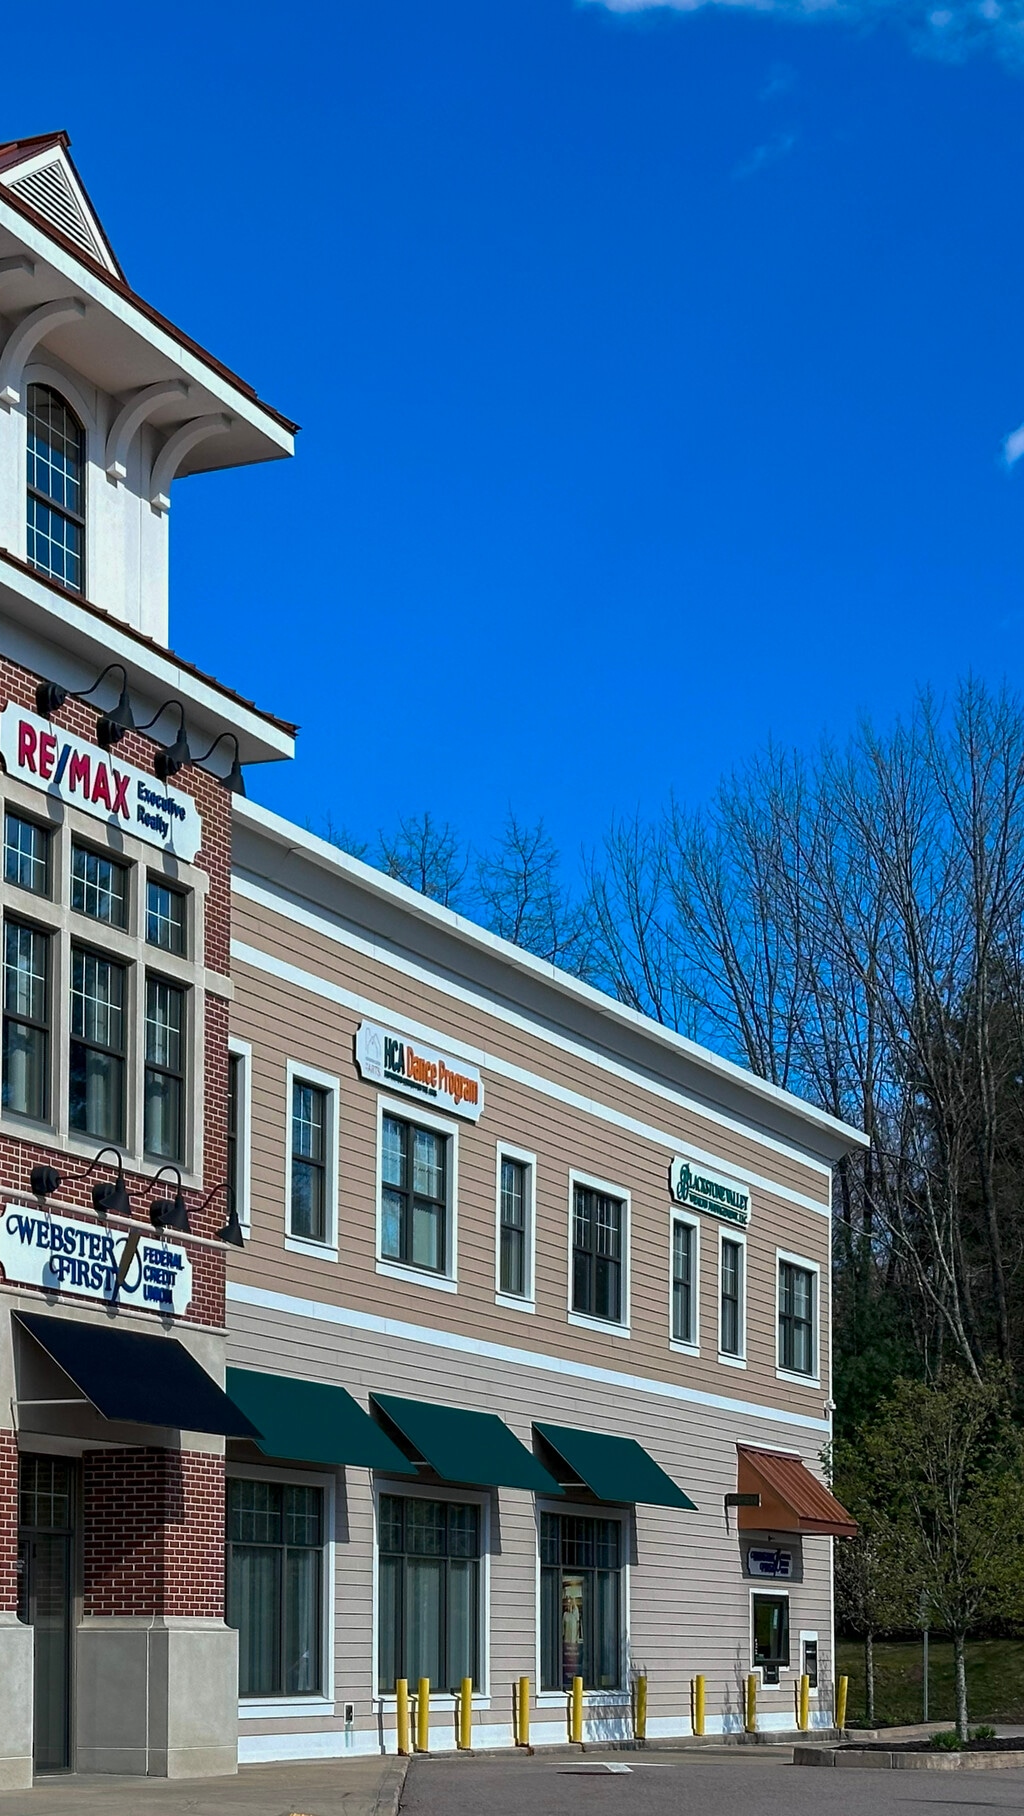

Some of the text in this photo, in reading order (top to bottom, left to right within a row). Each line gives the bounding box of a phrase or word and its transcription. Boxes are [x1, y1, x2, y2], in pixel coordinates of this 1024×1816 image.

[18, 719, 131, 820] RE/MAX
[137, 780, 187, 821] Executive
[137, 804, 170, 839] Realty
[384, 1036, 405, 1075] HCA
[406, 1046, 437, 1088] Dance
[438, 1060, 479, 1105] Program
[6, 1214, 118, 1270] WEBSTER
[143, 1246, 185, 1270] FEDERAL
[50, 1254, 118, 1291] FIRST
[143, 1265, 177, 1286] CREDIT
[143, 1284, 173, 1304] UNION
